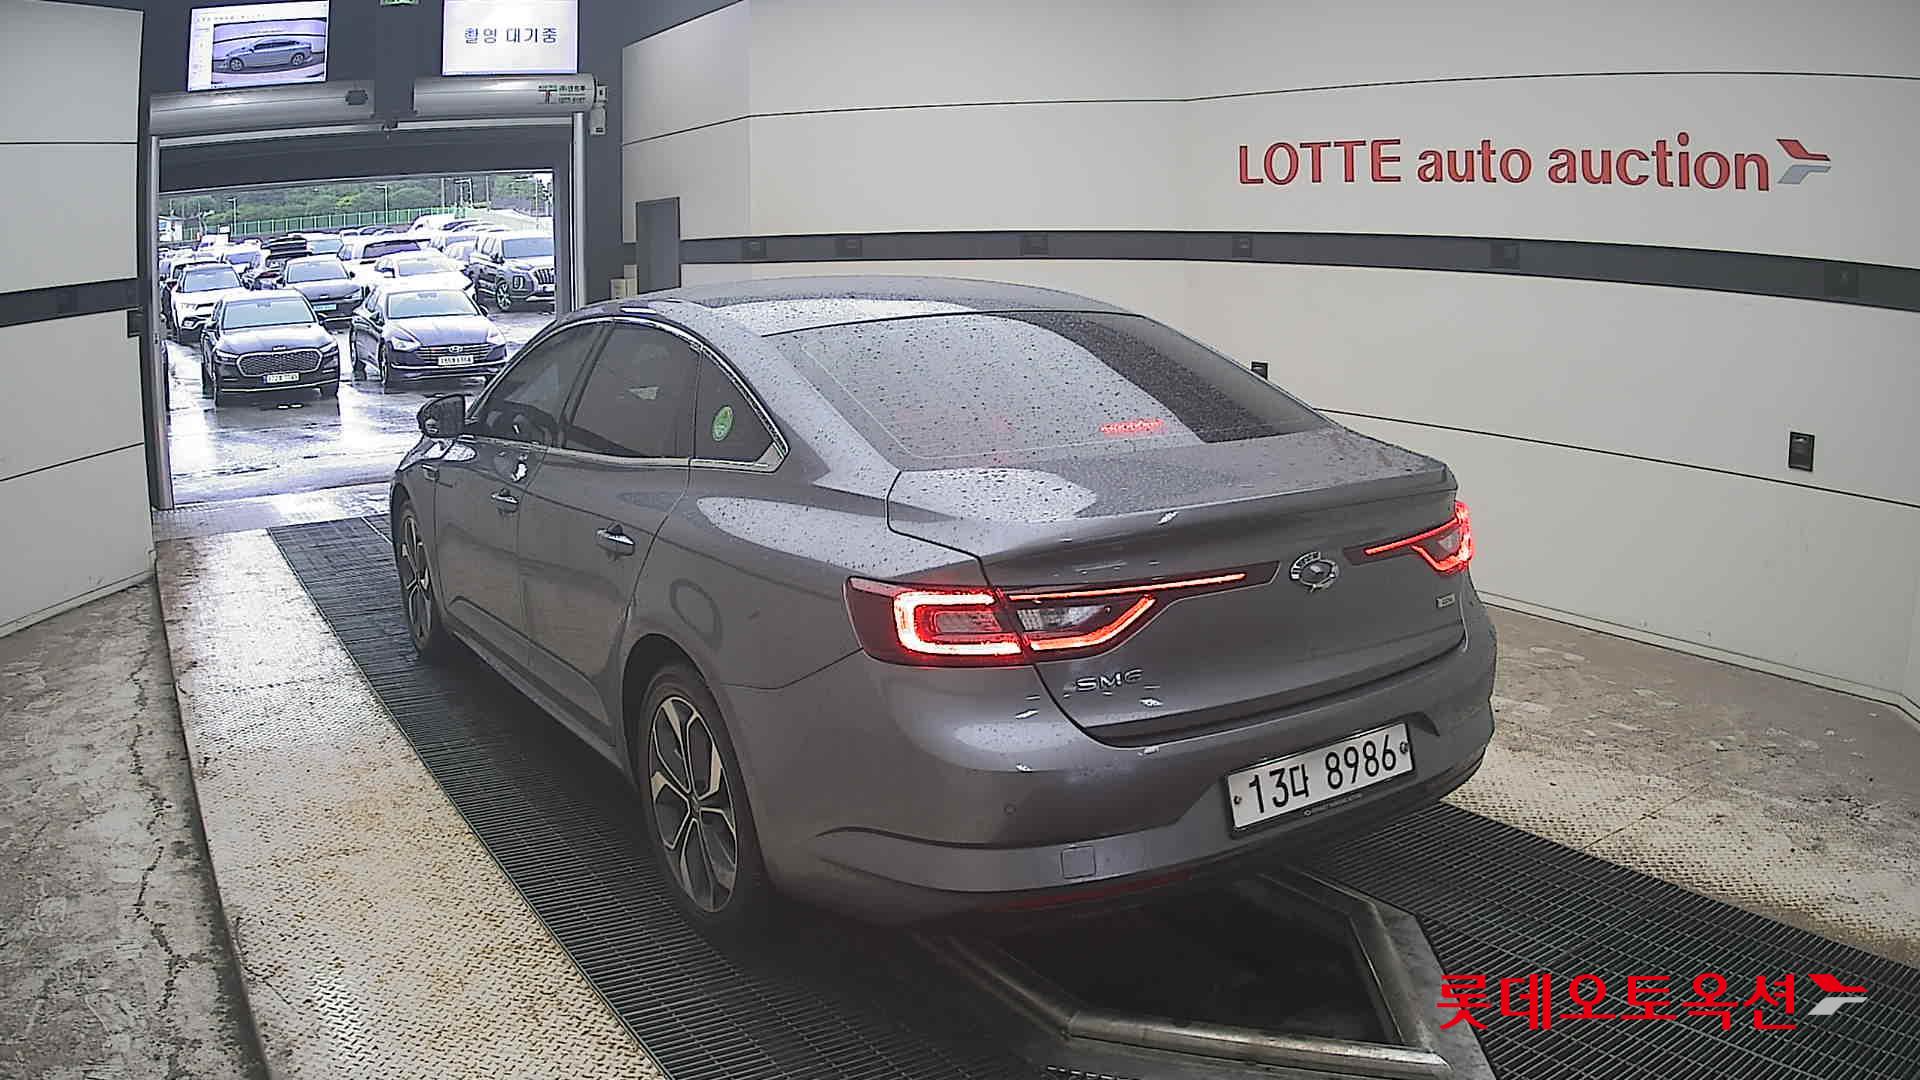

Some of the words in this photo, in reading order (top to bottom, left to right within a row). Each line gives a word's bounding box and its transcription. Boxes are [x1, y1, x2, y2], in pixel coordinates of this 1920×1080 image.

[505, 27, 558, 44] 대기중
[1238, 139, 1402, 186] LOTTE
[1417, 140, 1533, 183] auto
[1548, 132, 1770, 192] auction
[1248, 763, 1310, 814] 13다
[1324, 734, 1397, 790] 8986
